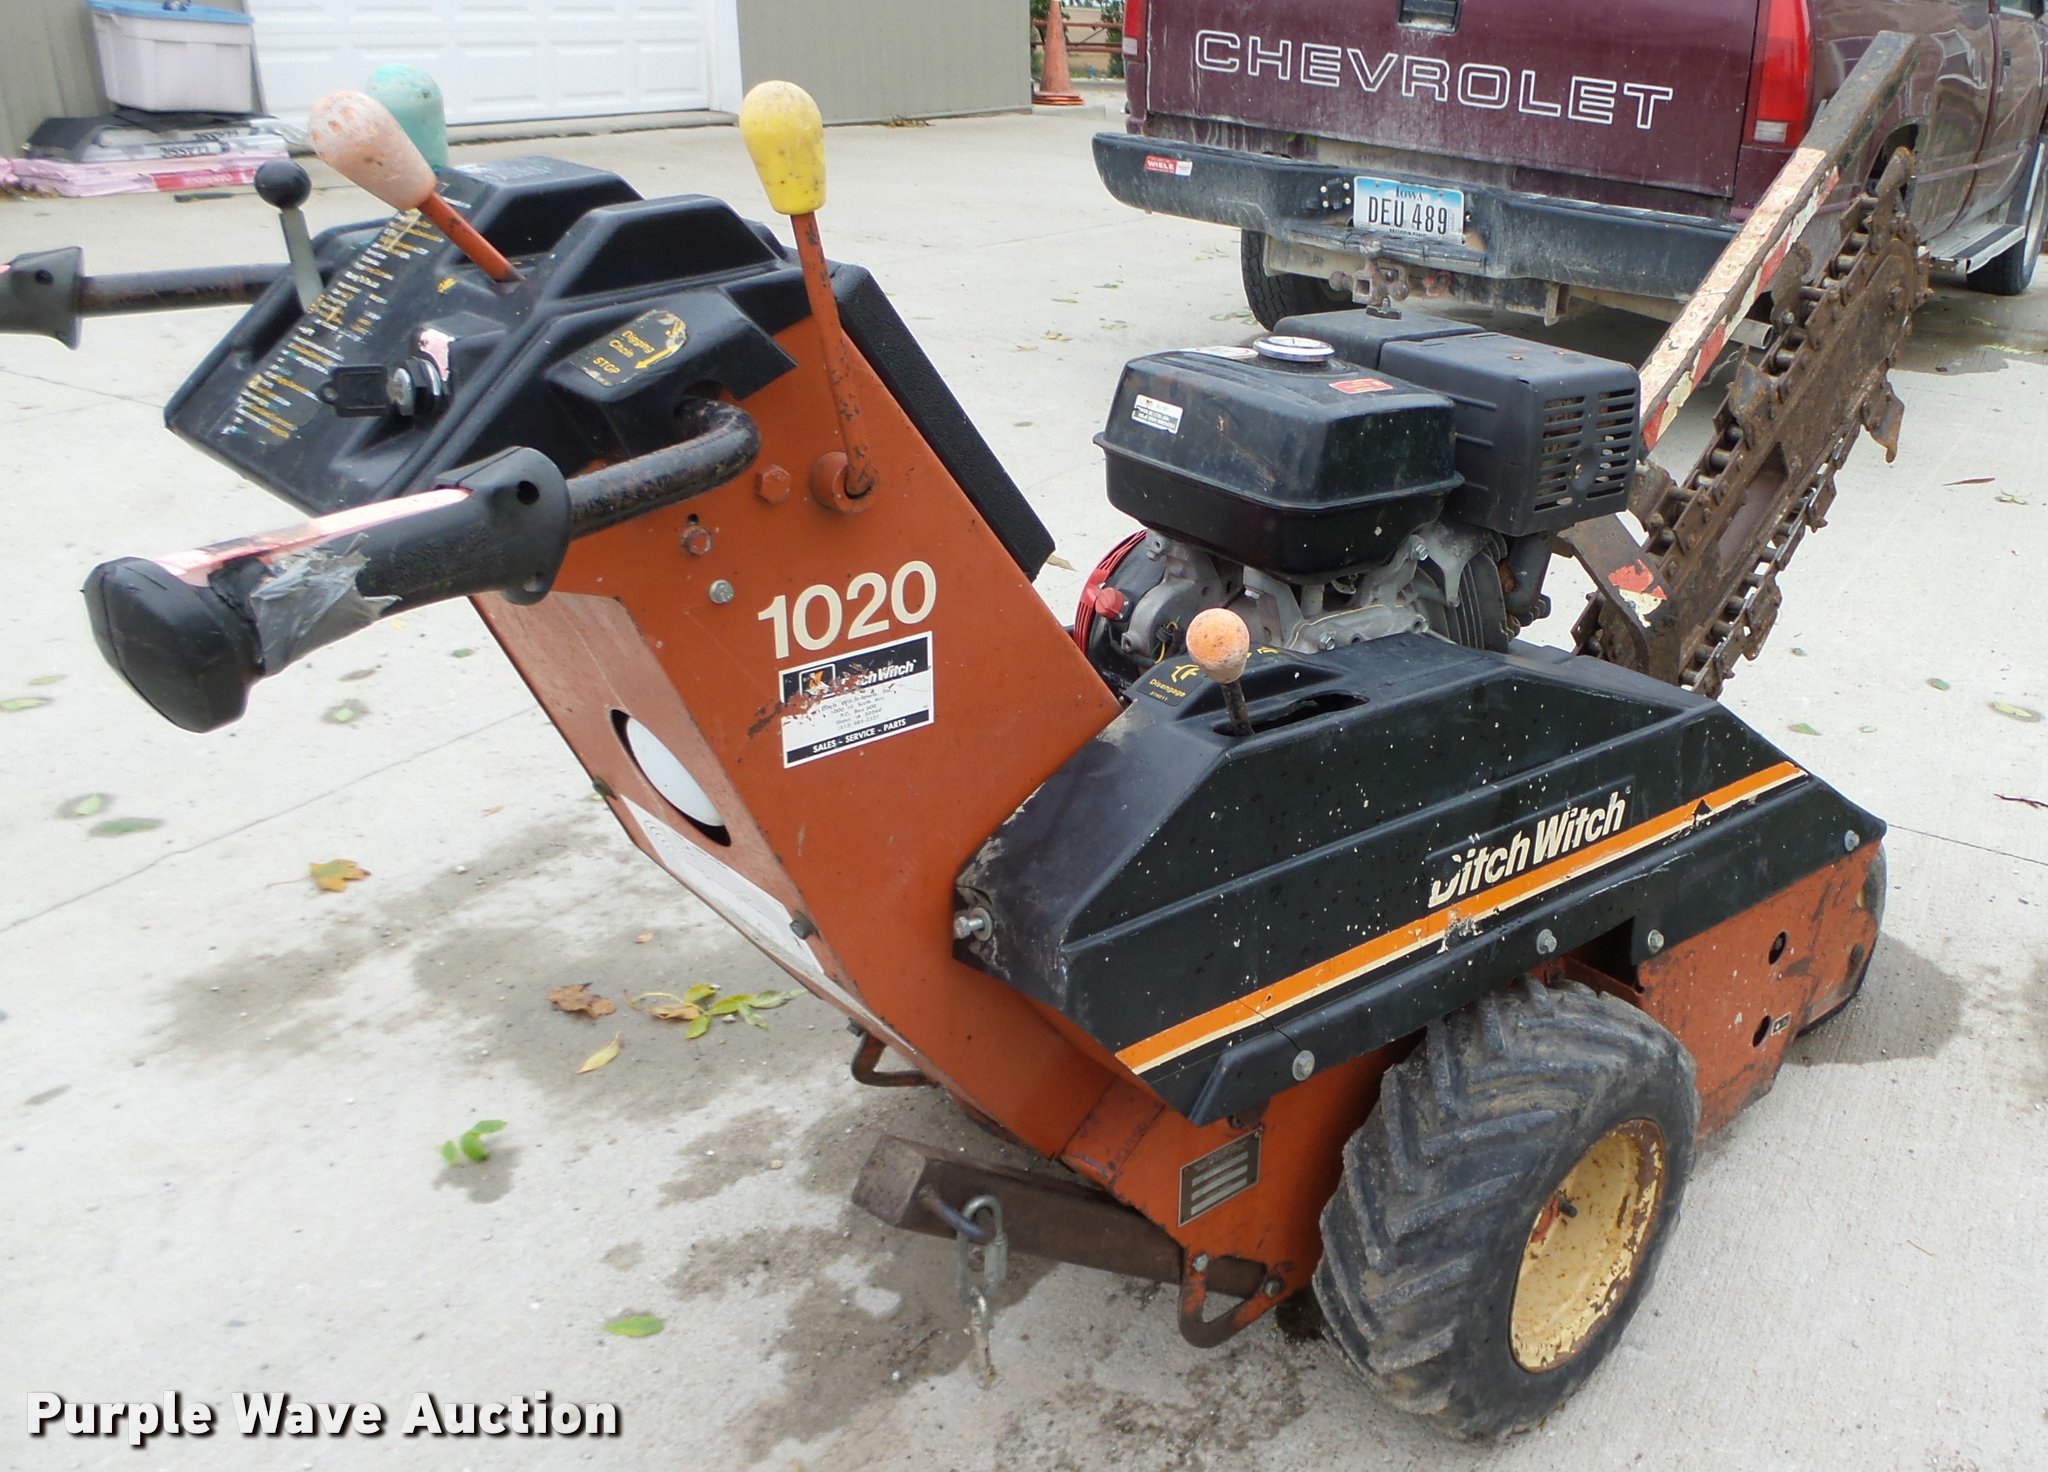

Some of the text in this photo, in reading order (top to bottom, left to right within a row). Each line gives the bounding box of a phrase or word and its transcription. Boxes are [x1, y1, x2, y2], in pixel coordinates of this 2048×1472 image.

[1195, 29, 1673, 130] CHEVROLET
[1395, 186, 1423, 201] IOWA
[1368, 196, 1447, 235] DEU 489
[593, 357, 621, 374] STOP
[757, 560, 937, 660] 1020
[1149, 678, 1186, 697] Disengage
[812, 740, 836, 753] SALES
[845, 728, 875, 743] SERVICE
[883, 718, 907, 732] PARTS
